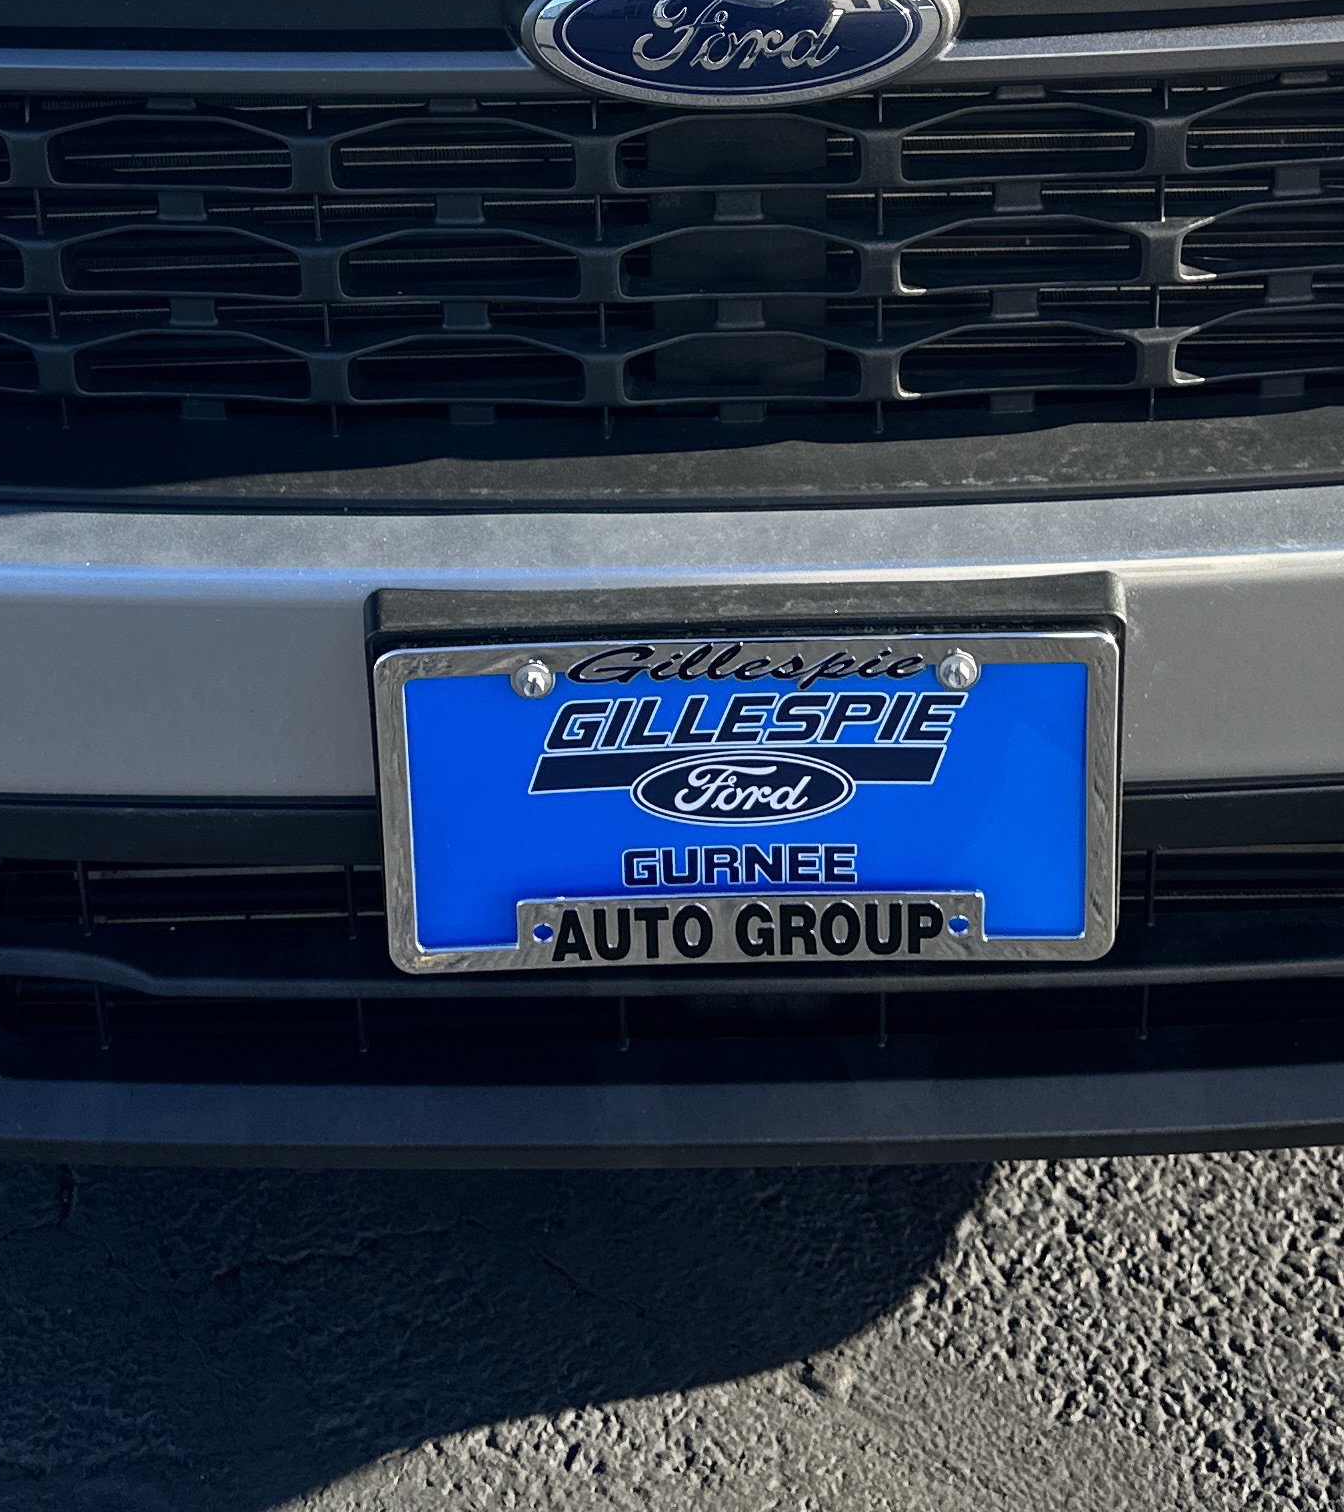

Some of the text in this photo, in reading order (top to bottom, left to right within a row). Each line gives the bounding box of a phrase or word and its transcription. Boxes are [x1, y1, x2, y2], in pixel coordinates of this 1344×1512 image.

[567, 641, 927, 690] Gillespie
[546, 691, 968, 752] GILLESPIE
[674, 764, 812, 813] Ford
[622, 843, 858, 888] GURNEE
[552, 899, 945, 963] AUTO GROUP
